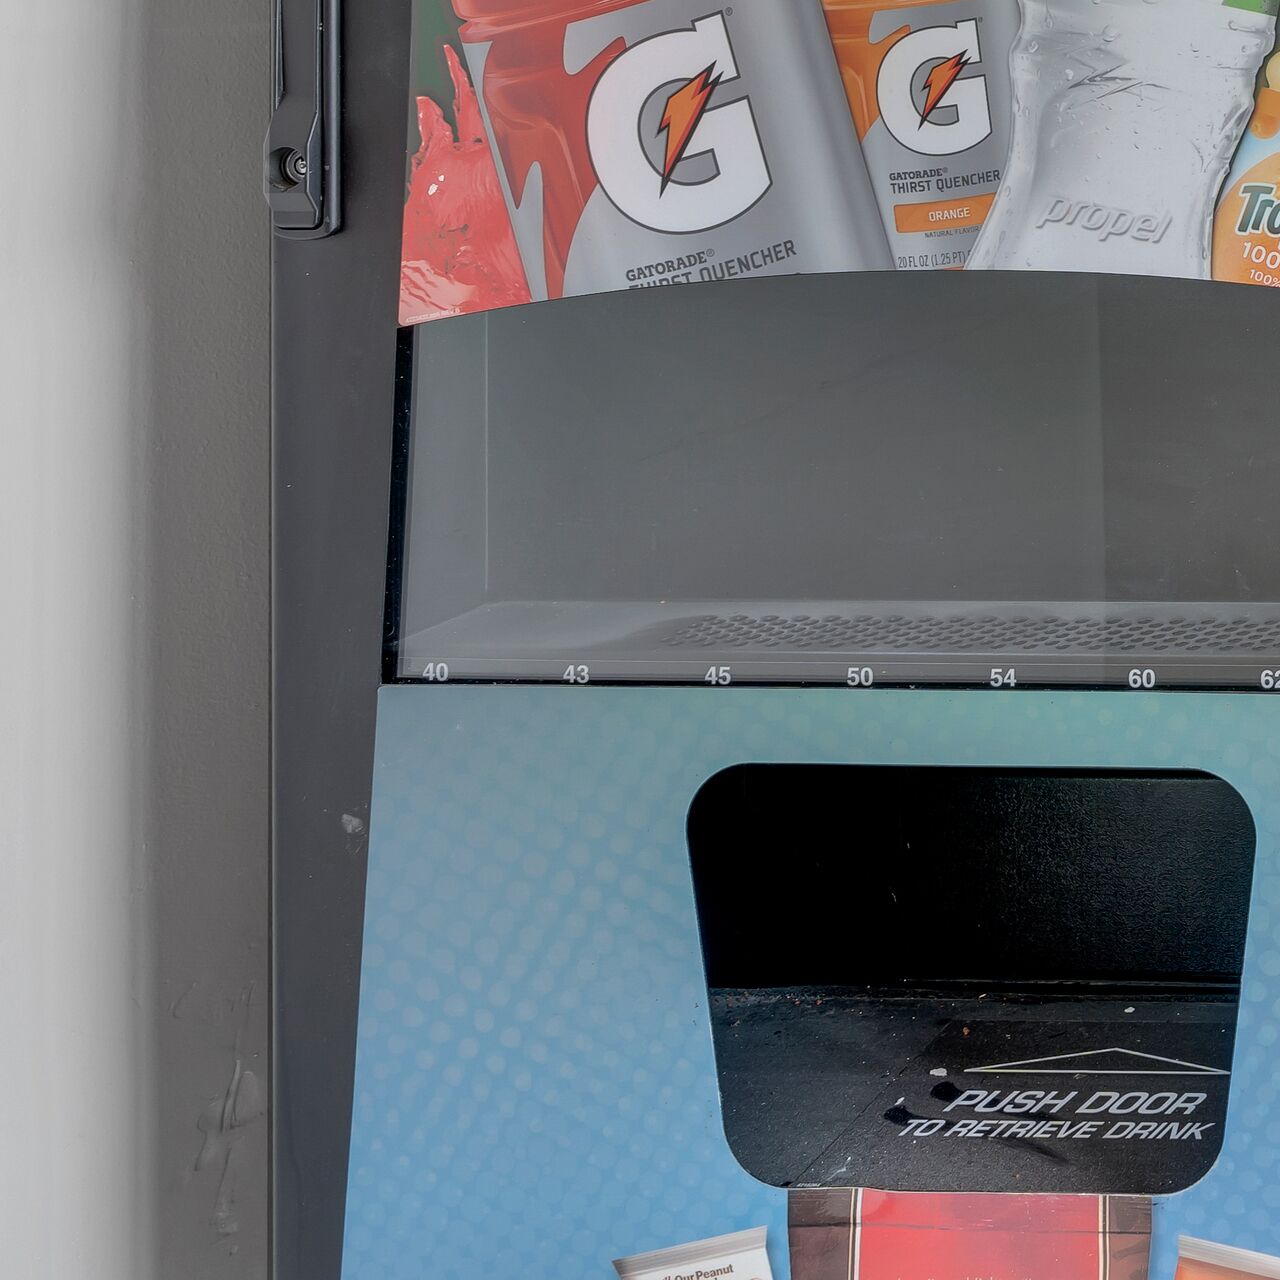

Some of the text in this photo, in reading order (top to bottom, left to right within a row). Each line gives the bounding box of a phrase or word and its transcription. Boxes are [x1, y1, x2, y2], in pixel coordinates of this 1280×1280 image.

[876, 18, 994, 157] G
[585, 10, 774, 235] G
[889, 168, 943, 181] GATORADE
[890, 170, 1001, 194] THIRST QUENCHER
[928, 207, 971, 221] ORANGE
[1036, 197, 1174, 243] propel
[626, 251, 707, 282] GATORADE
[422, 663, 449, 681] 40
[563, 665, 590, 683] 43
[704, 666, 731, 685] 45
[846, 667, 873, 686] 50
[989, 669, 1017, 688] 54
[1128, 669, 1156, 688] 60
[942, 1090, 1207, 1114] PUSH DOOR
[897, 1119, 1216, 1140] TO RETRIEVE DRINK
